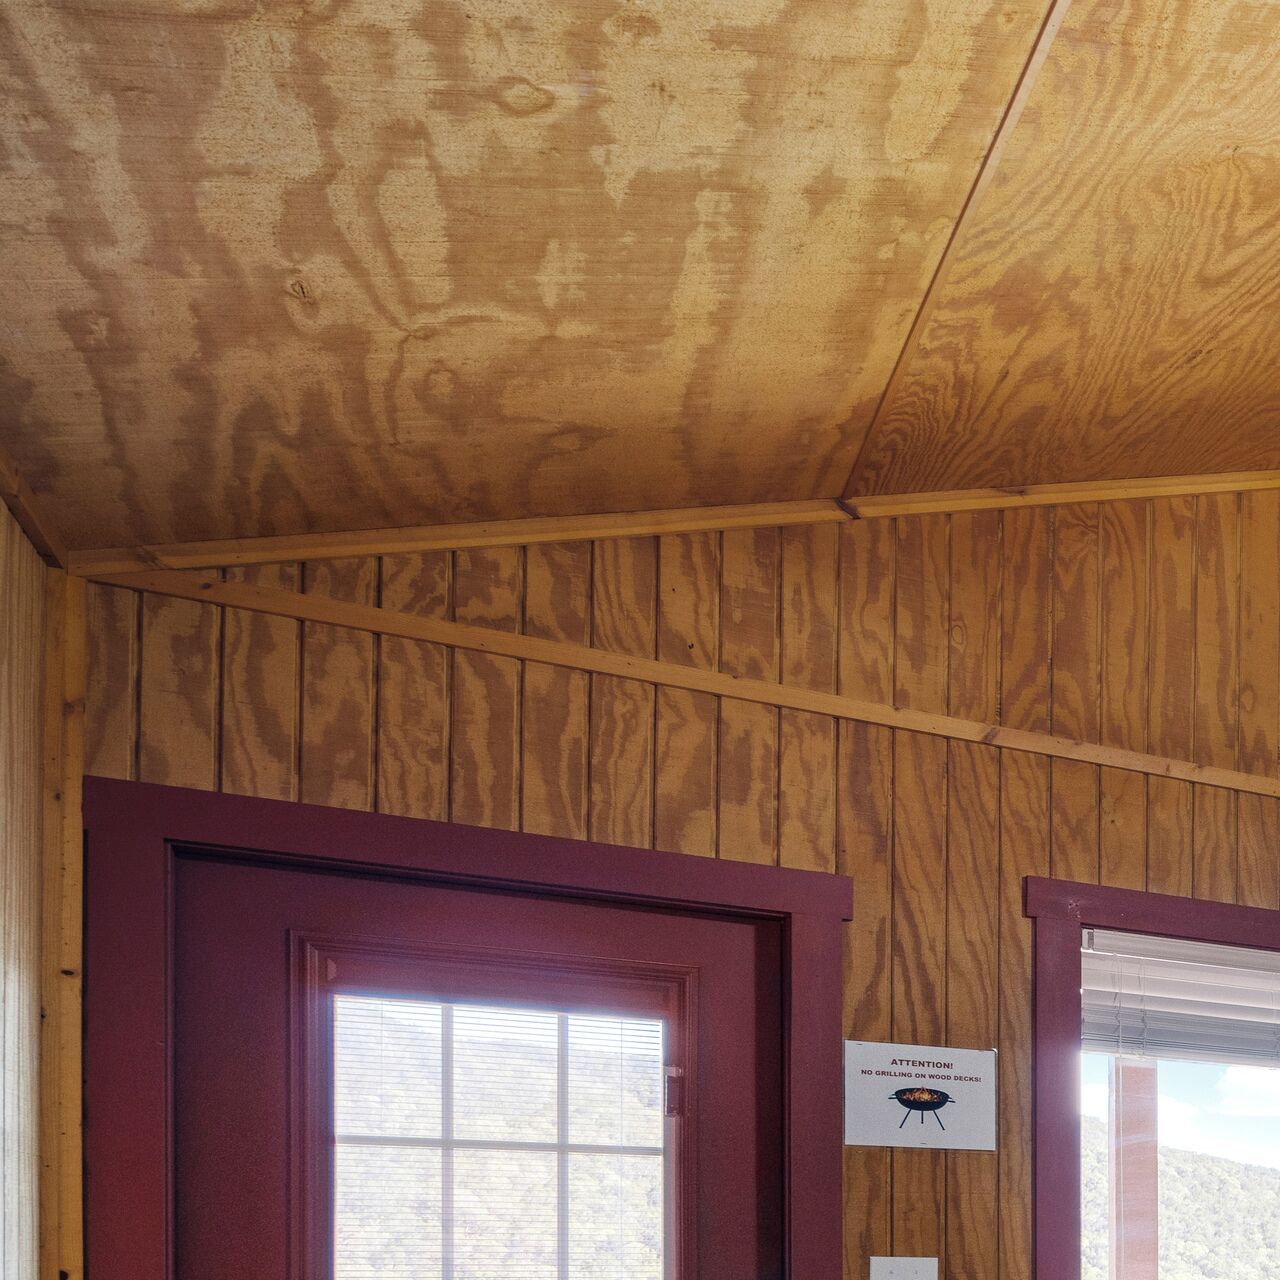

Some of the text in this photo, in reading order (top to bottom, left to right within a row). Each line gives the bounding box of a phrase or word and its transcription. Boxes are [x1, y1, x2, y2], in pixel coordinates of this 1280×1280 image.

[891, 1058, 953, 1069] ATTENTION!
[875, 1070, 913, 1078] GRILLING
[953, 1075, 982, 1083] DECKS!
